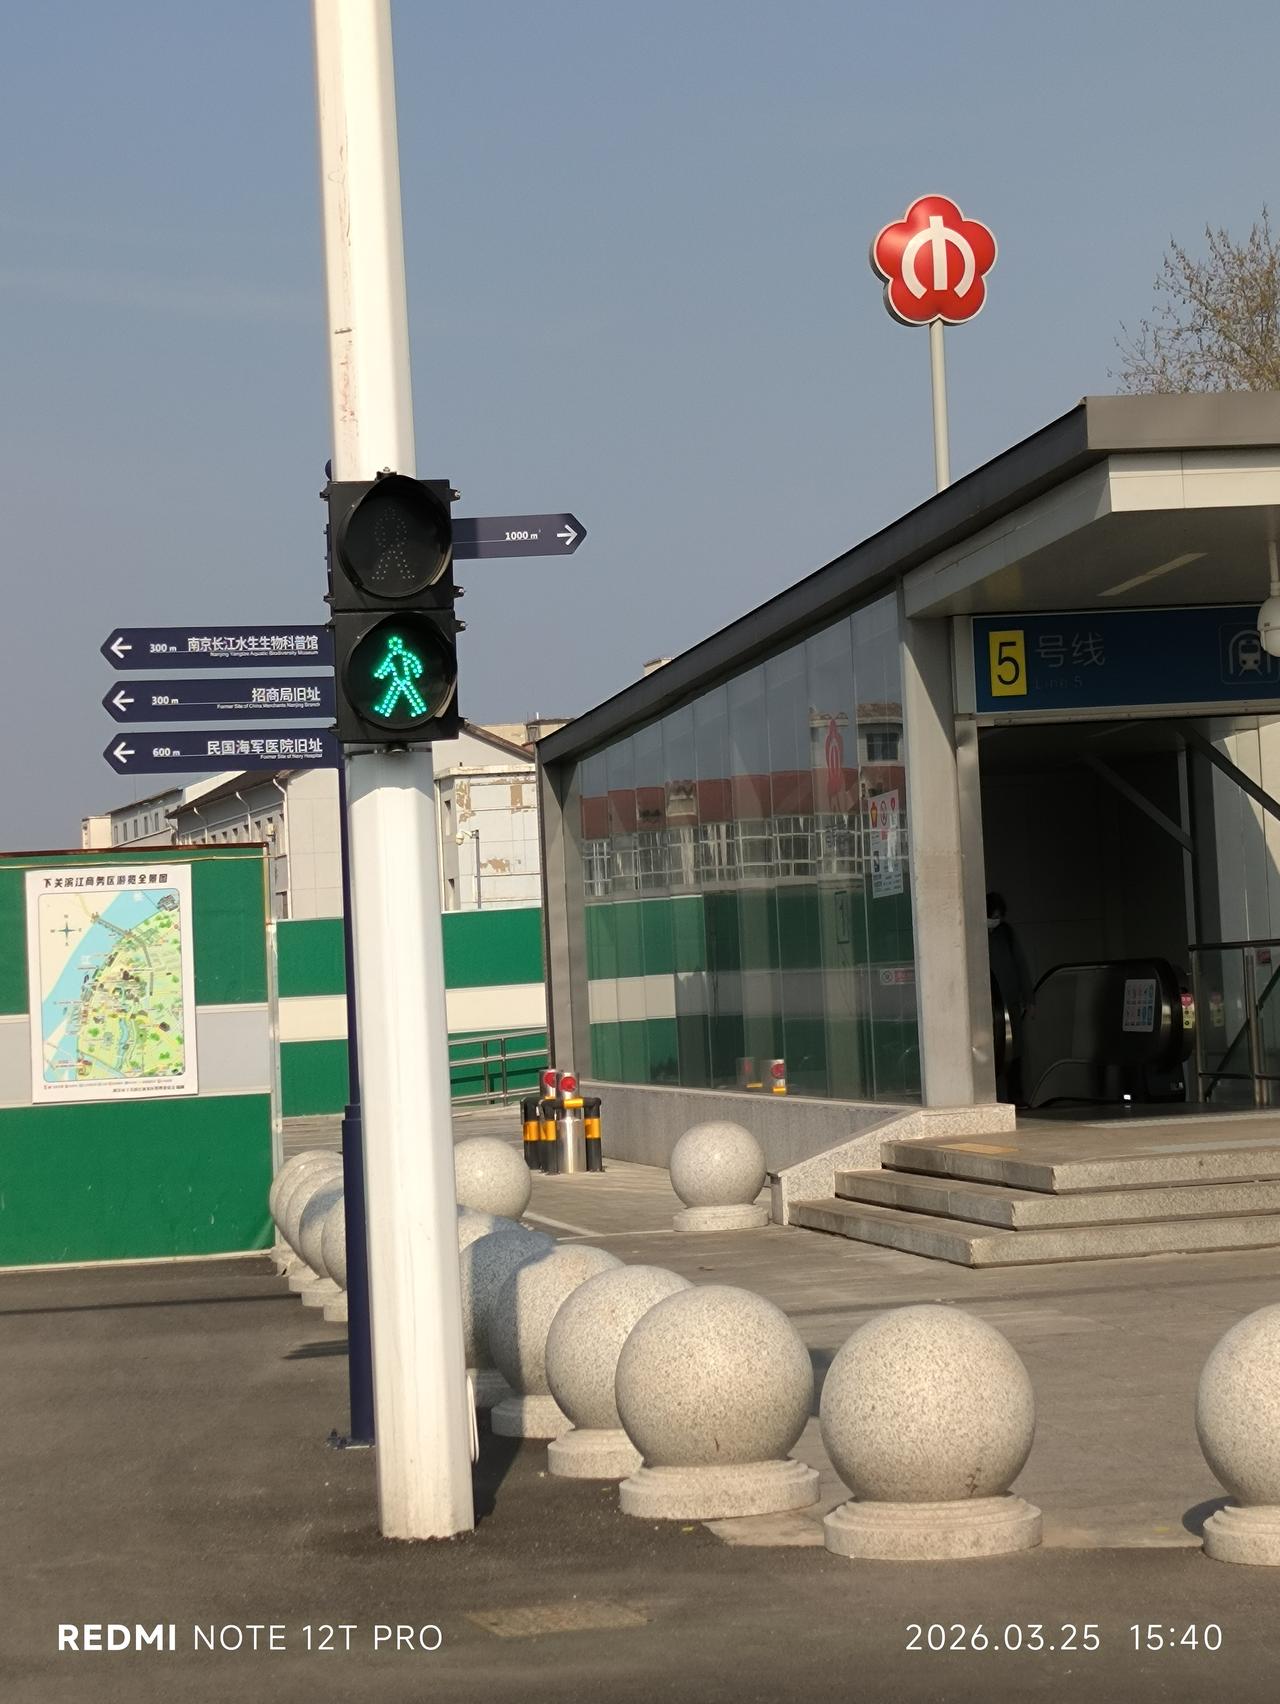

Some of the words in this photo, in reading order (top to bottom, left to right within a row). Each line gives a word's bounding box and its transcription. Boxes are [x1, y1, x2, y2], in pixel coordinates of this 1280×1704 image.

[505, 531, 529, 541] 1000
[150, 643, 168, 653] 300
[187, 635, 319, 652] 南京长江水生生物科普馆
[997, 641, 1020, 686] 5
[1035, 632, 1106, 668] 号线
[152, 696, 170, 705] 300
[252, 686, 321, 703] 招商局旧址
[153, 747, 171, 757] 600
[207, 738, 323, 755] 民国海军医院旧址
